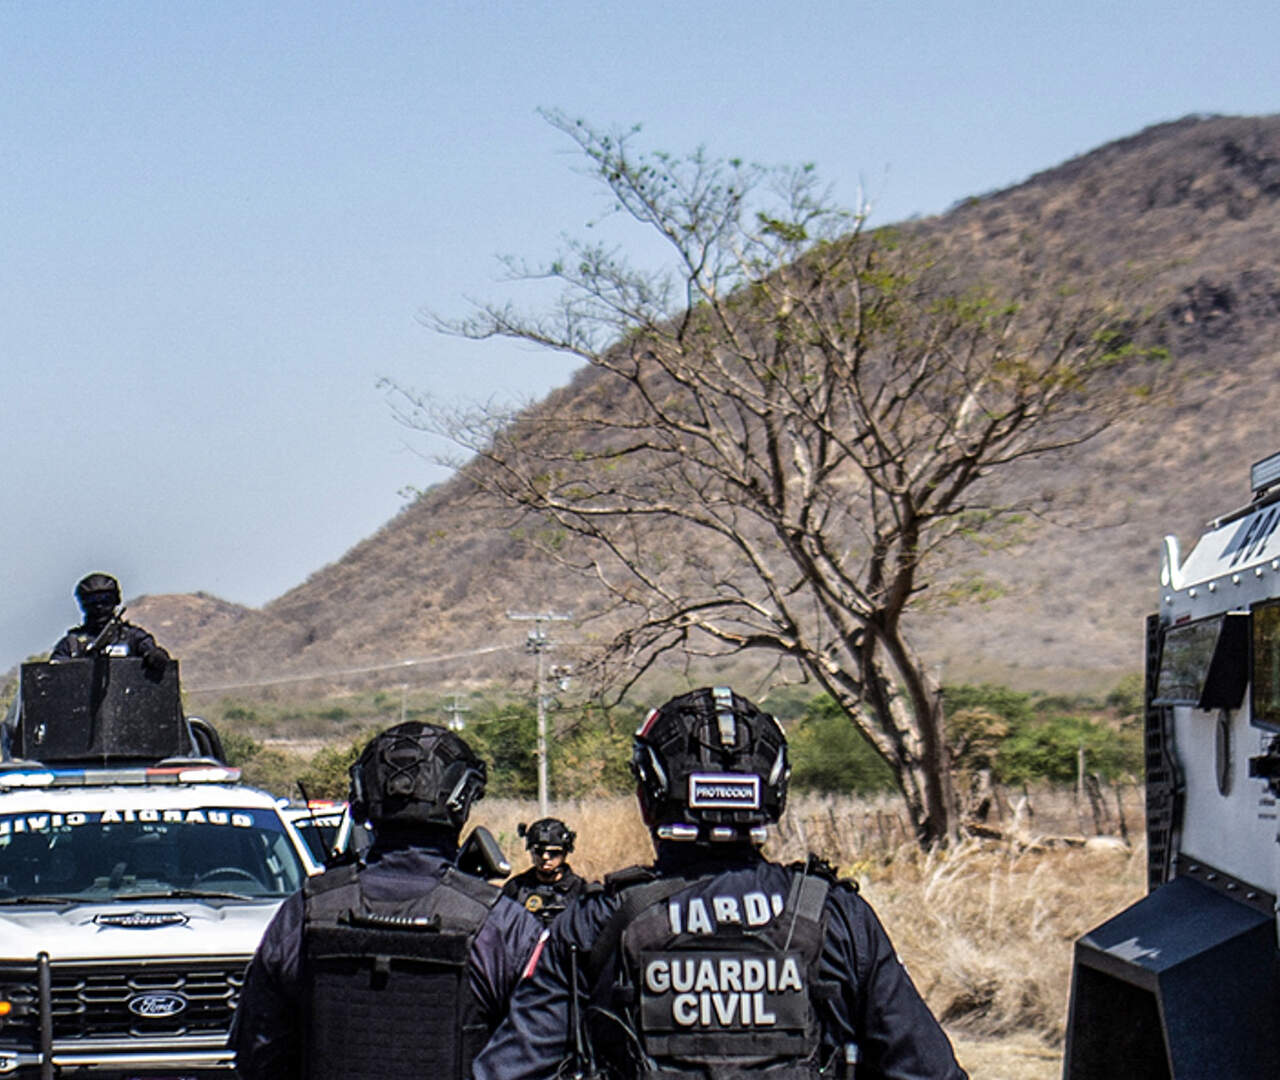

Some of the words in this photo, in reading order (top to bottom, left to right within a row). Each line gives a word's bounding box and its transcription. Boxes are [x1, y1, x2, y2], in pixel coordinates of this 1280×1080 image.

[645, 957, 802, 993] GUARDIA
[140, 996, 176, 1014] Ford
[672, 992, 776, 1026] CIVIL
